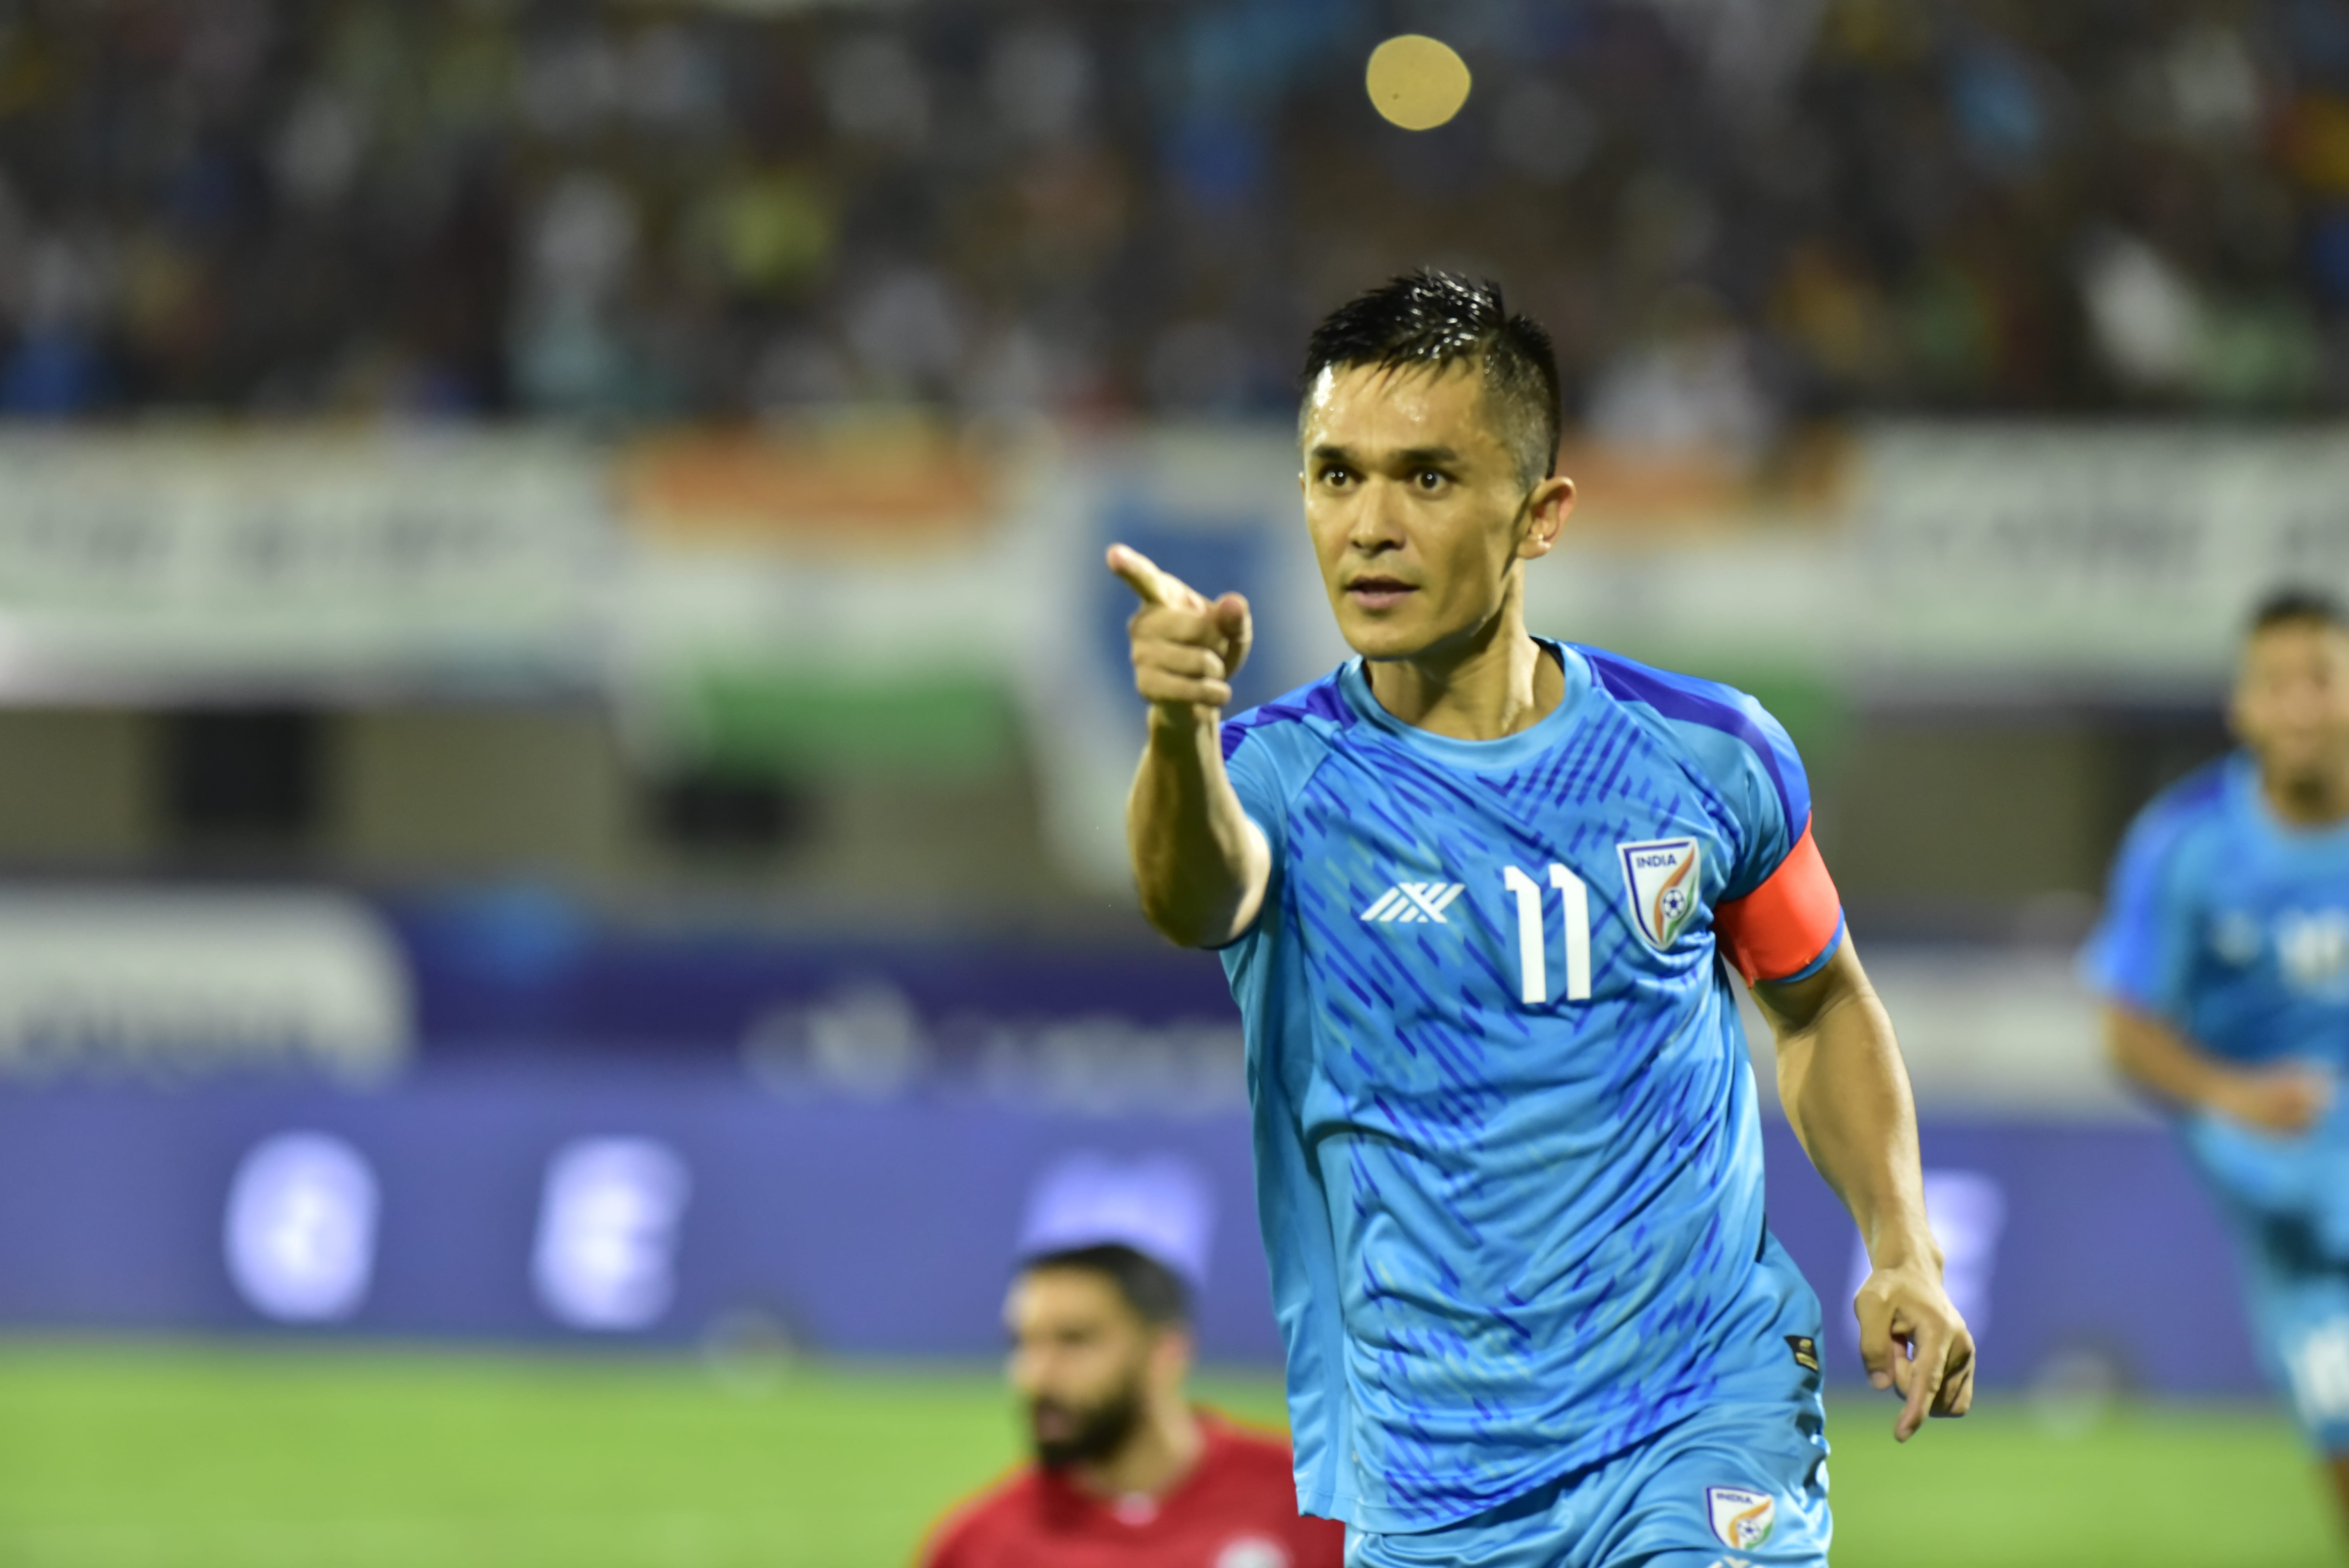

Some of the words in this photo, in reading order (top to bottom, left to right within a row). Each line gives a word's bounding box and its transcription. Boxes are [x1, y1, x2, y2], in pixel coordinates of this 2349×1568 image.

[1636, 853, 1677, 868] INDIA
[1504, 863, 1591, 1004] 11
[1716, 1493, 1753, 1504] INDIA
